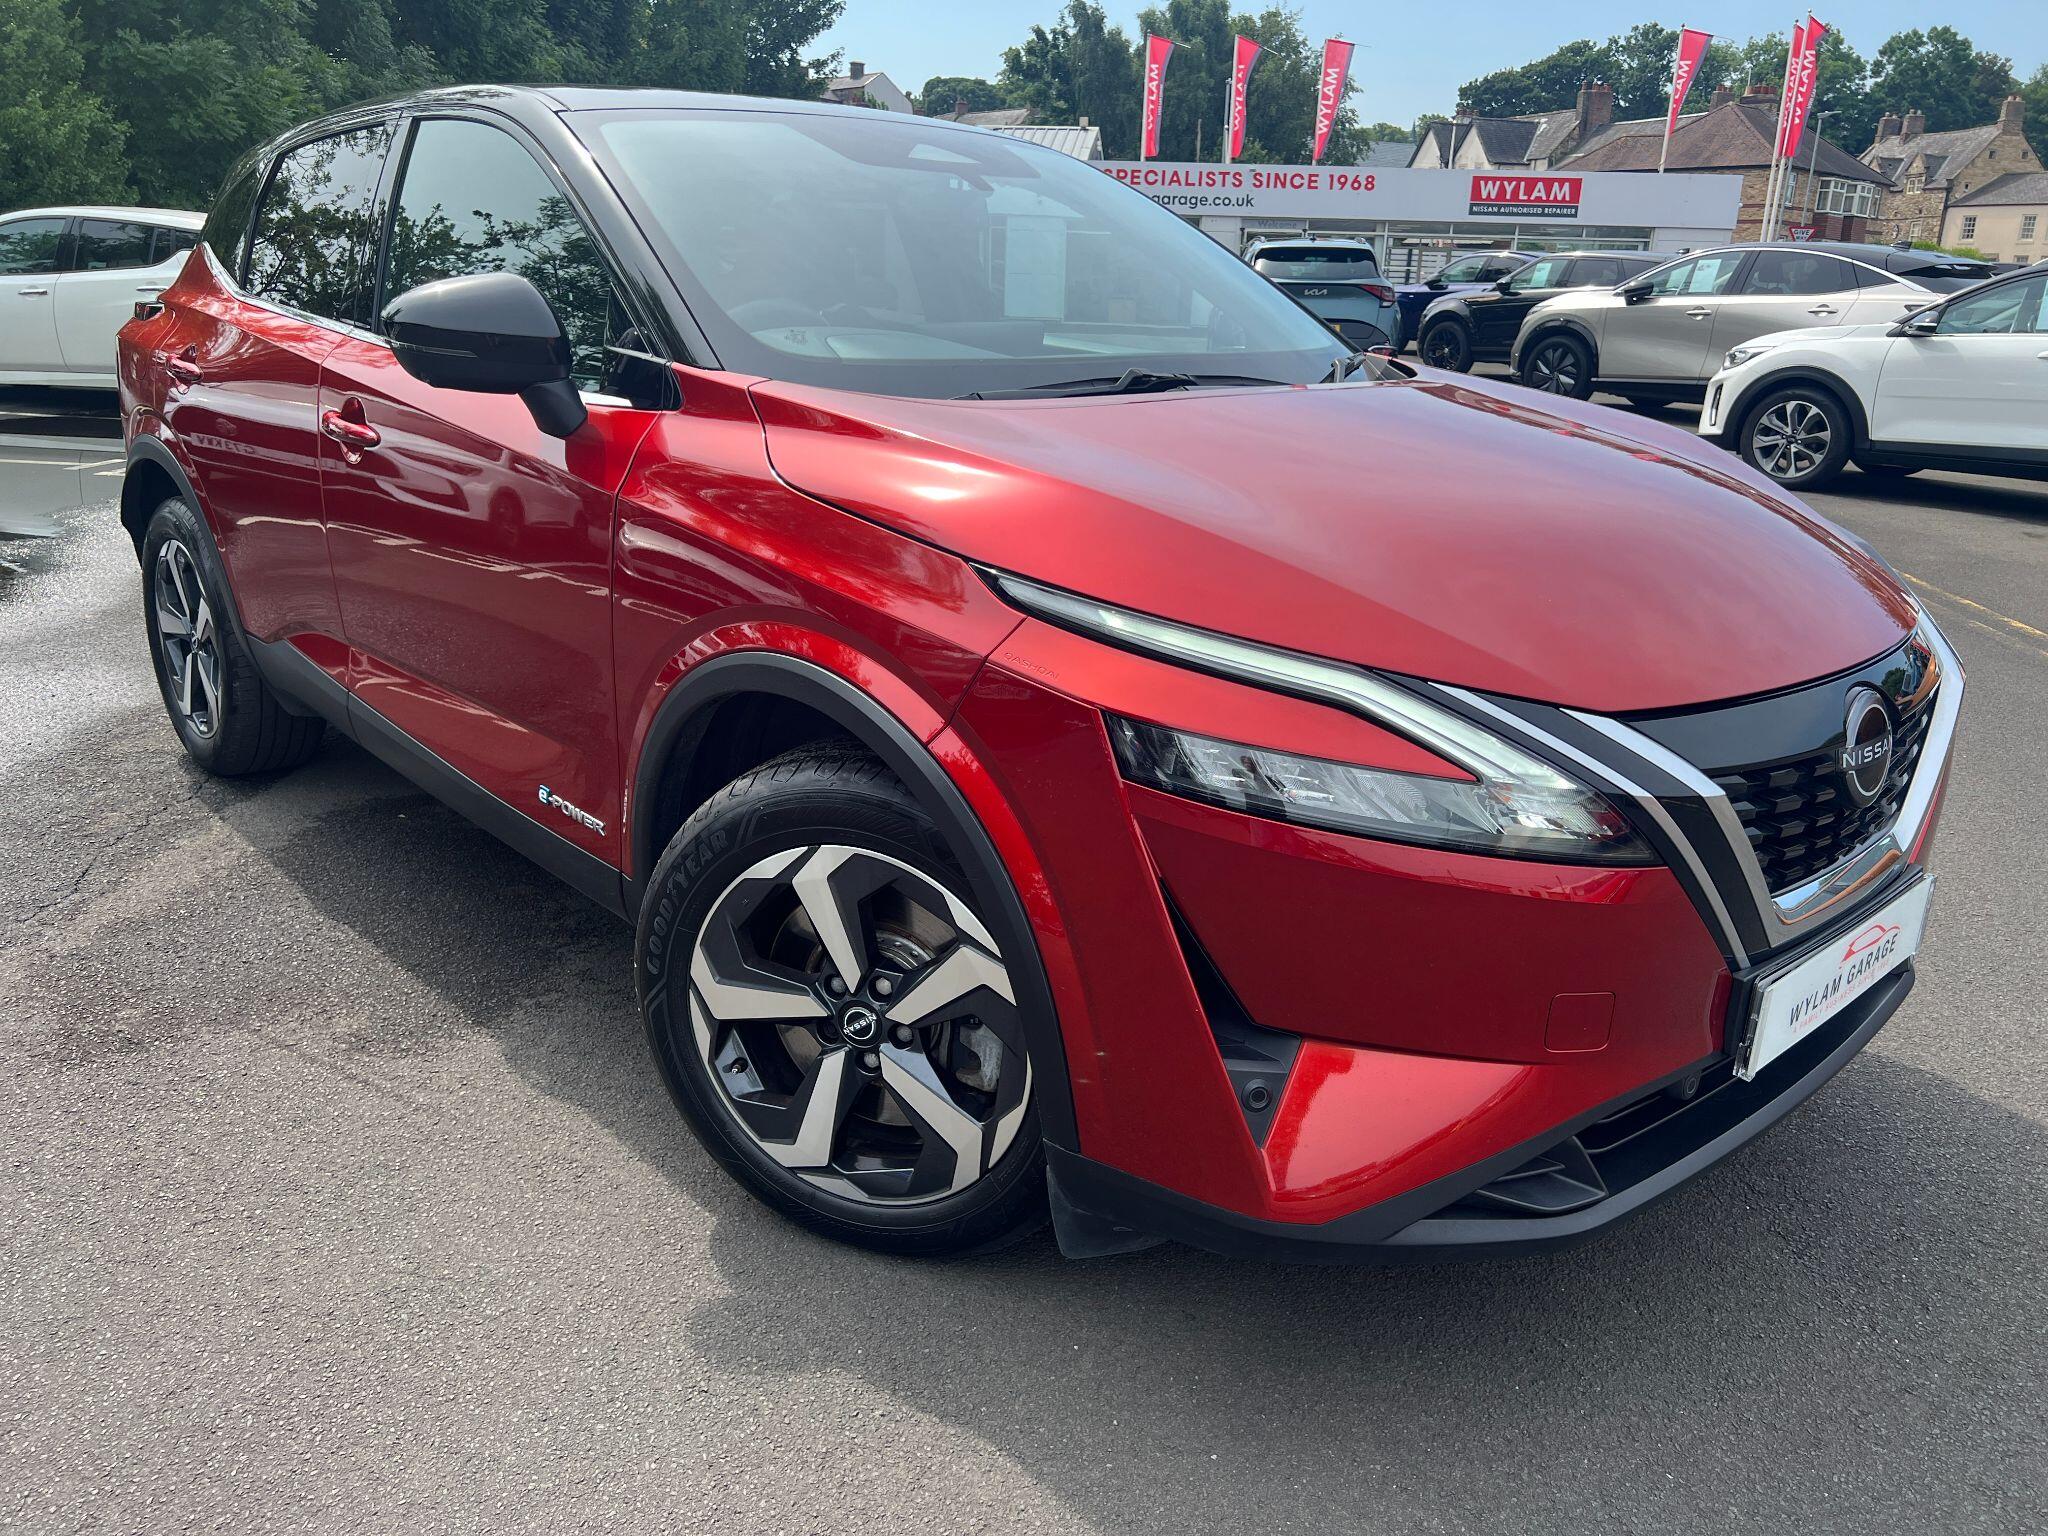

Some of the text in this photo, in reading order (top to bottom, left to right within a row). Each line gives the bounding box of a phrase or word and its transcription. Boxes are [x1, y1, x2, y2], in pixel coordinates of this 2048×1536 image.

[1147, 64, 1159, 130] WYLAM
[1318, 68, 1340, 135] WYLAM
[1794, 49, 1816, 124] WYLAM
[1252, 172, 1319, 190] SINCE
[1329, 173, 1376, 191] 1968
[1480, 181, 1570, 201] WYLAM
[1500, 206, 1542, 214] AUTHORISED
[1790, 933, 1899, 1027] WYLAM GARAGE
[843, 1012, 877, 1036] NISSAN
